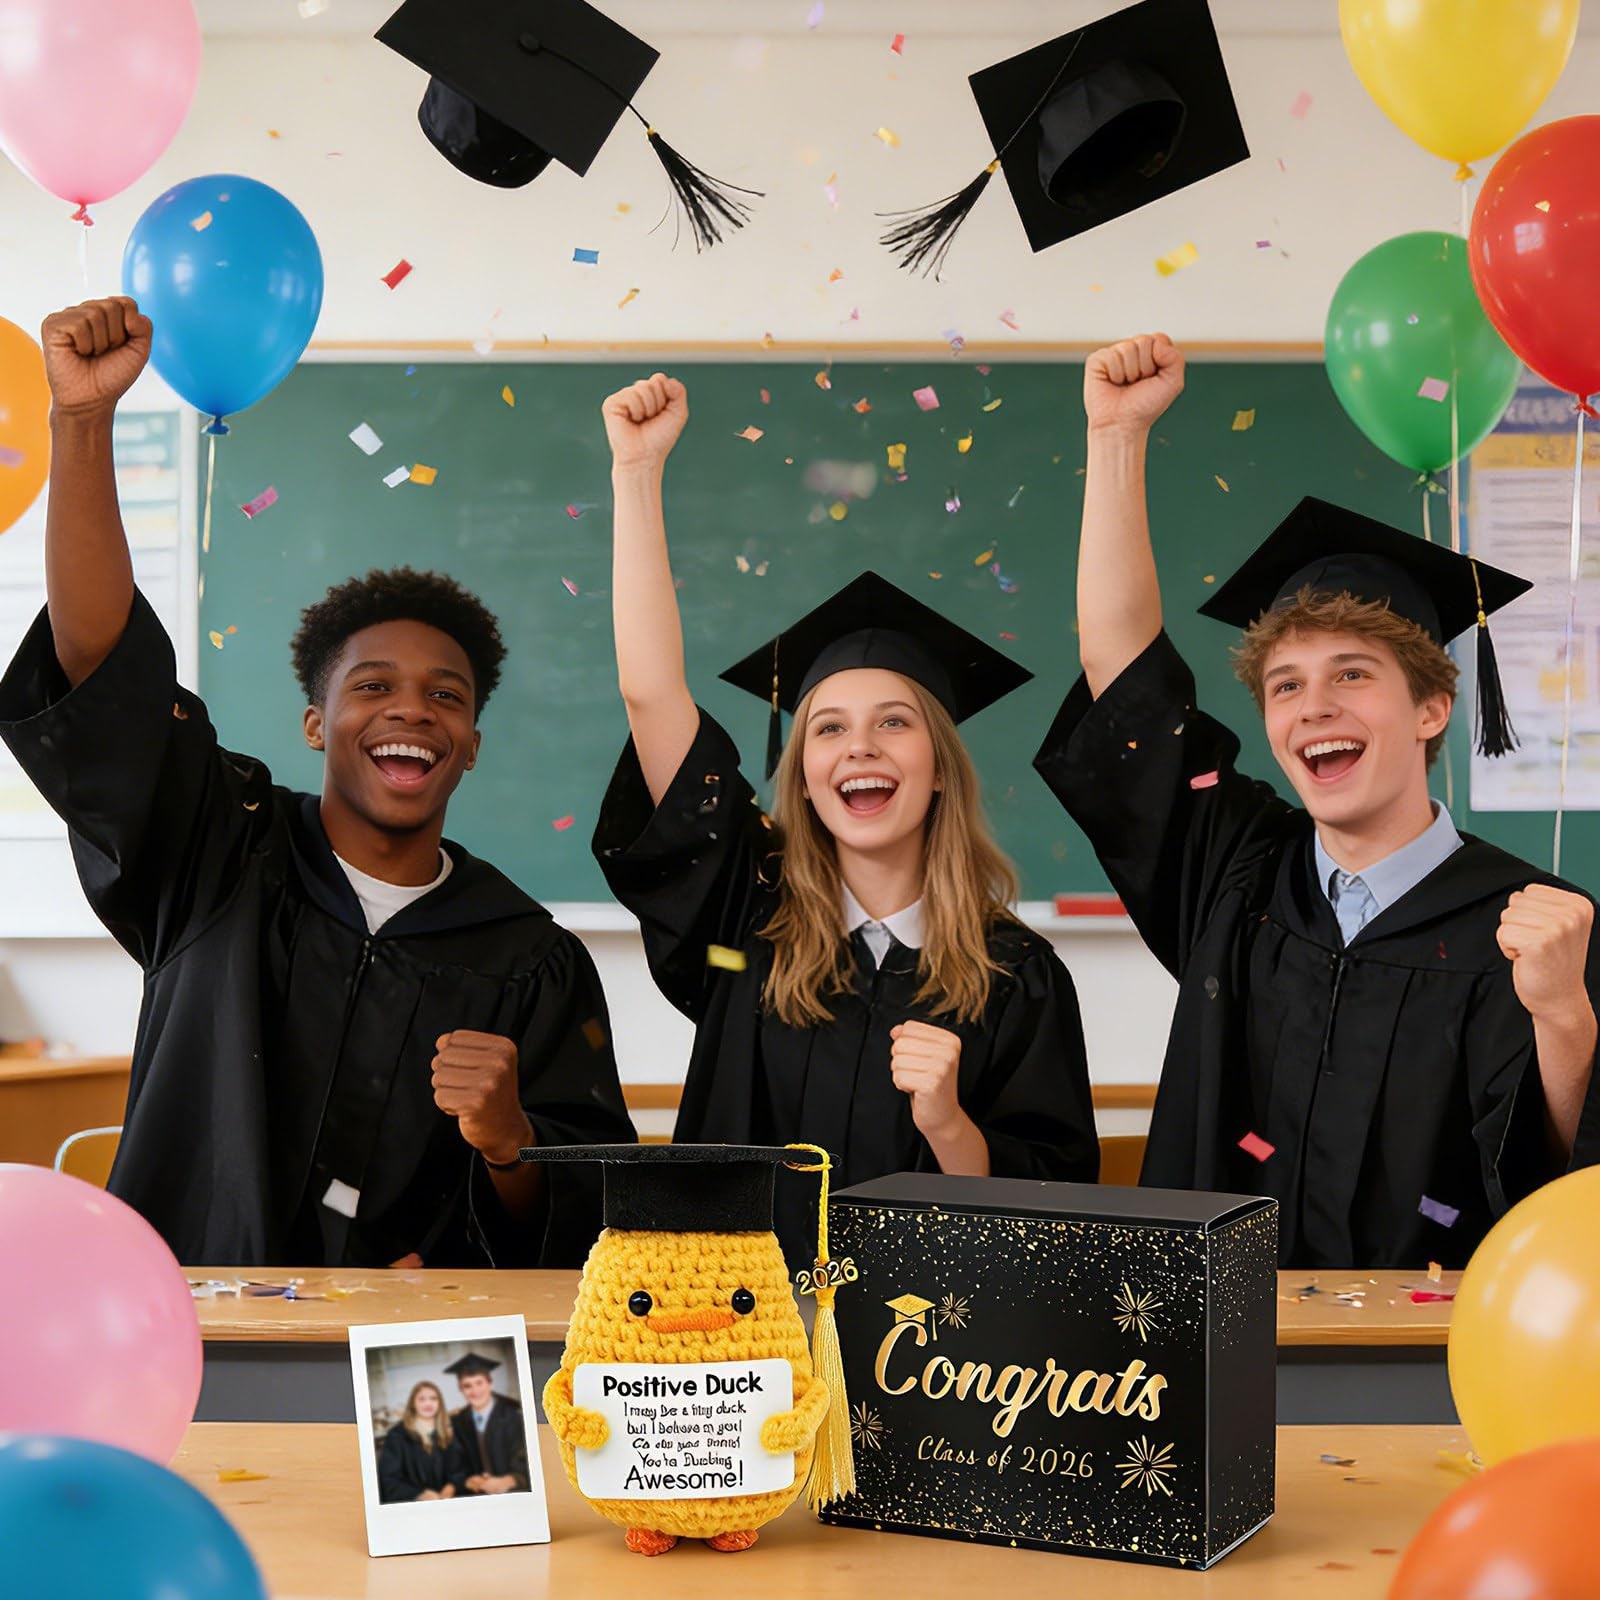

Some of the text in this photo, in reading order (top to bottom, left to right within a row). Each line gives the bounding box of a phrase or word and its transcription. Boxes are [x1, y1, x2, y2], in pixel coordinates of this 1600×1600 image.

[796, 1257, 859, 1295] 2026
[602, 1371, 764, 1397] Positive Duck
[874, 1321, 1168, 1437] Congrats
[716, 1400, 747, 1414] duck
[917, 1435, 1094, 1478] Class of 2026
[624, 1460, 744, 1491] Awesome!
